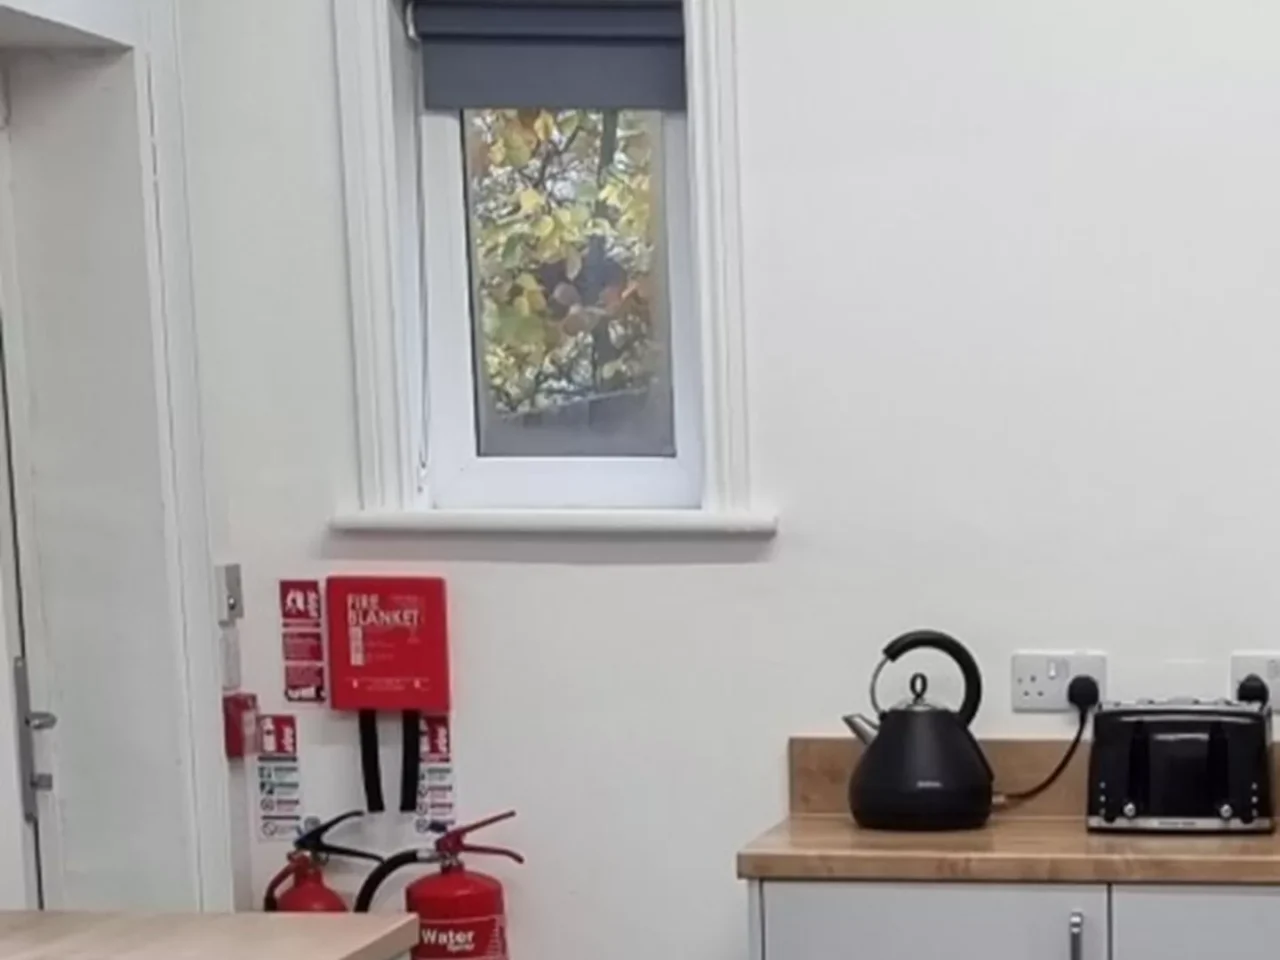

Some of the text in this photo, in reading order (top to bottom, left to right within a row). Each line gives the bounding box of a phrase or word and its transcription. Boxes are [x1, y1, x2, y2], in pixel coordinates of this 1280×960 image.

[346, 593, 380, 609] FIRE
[347, 609, 420, 626] BLANKET
[421, 928, 476, 945] Water
